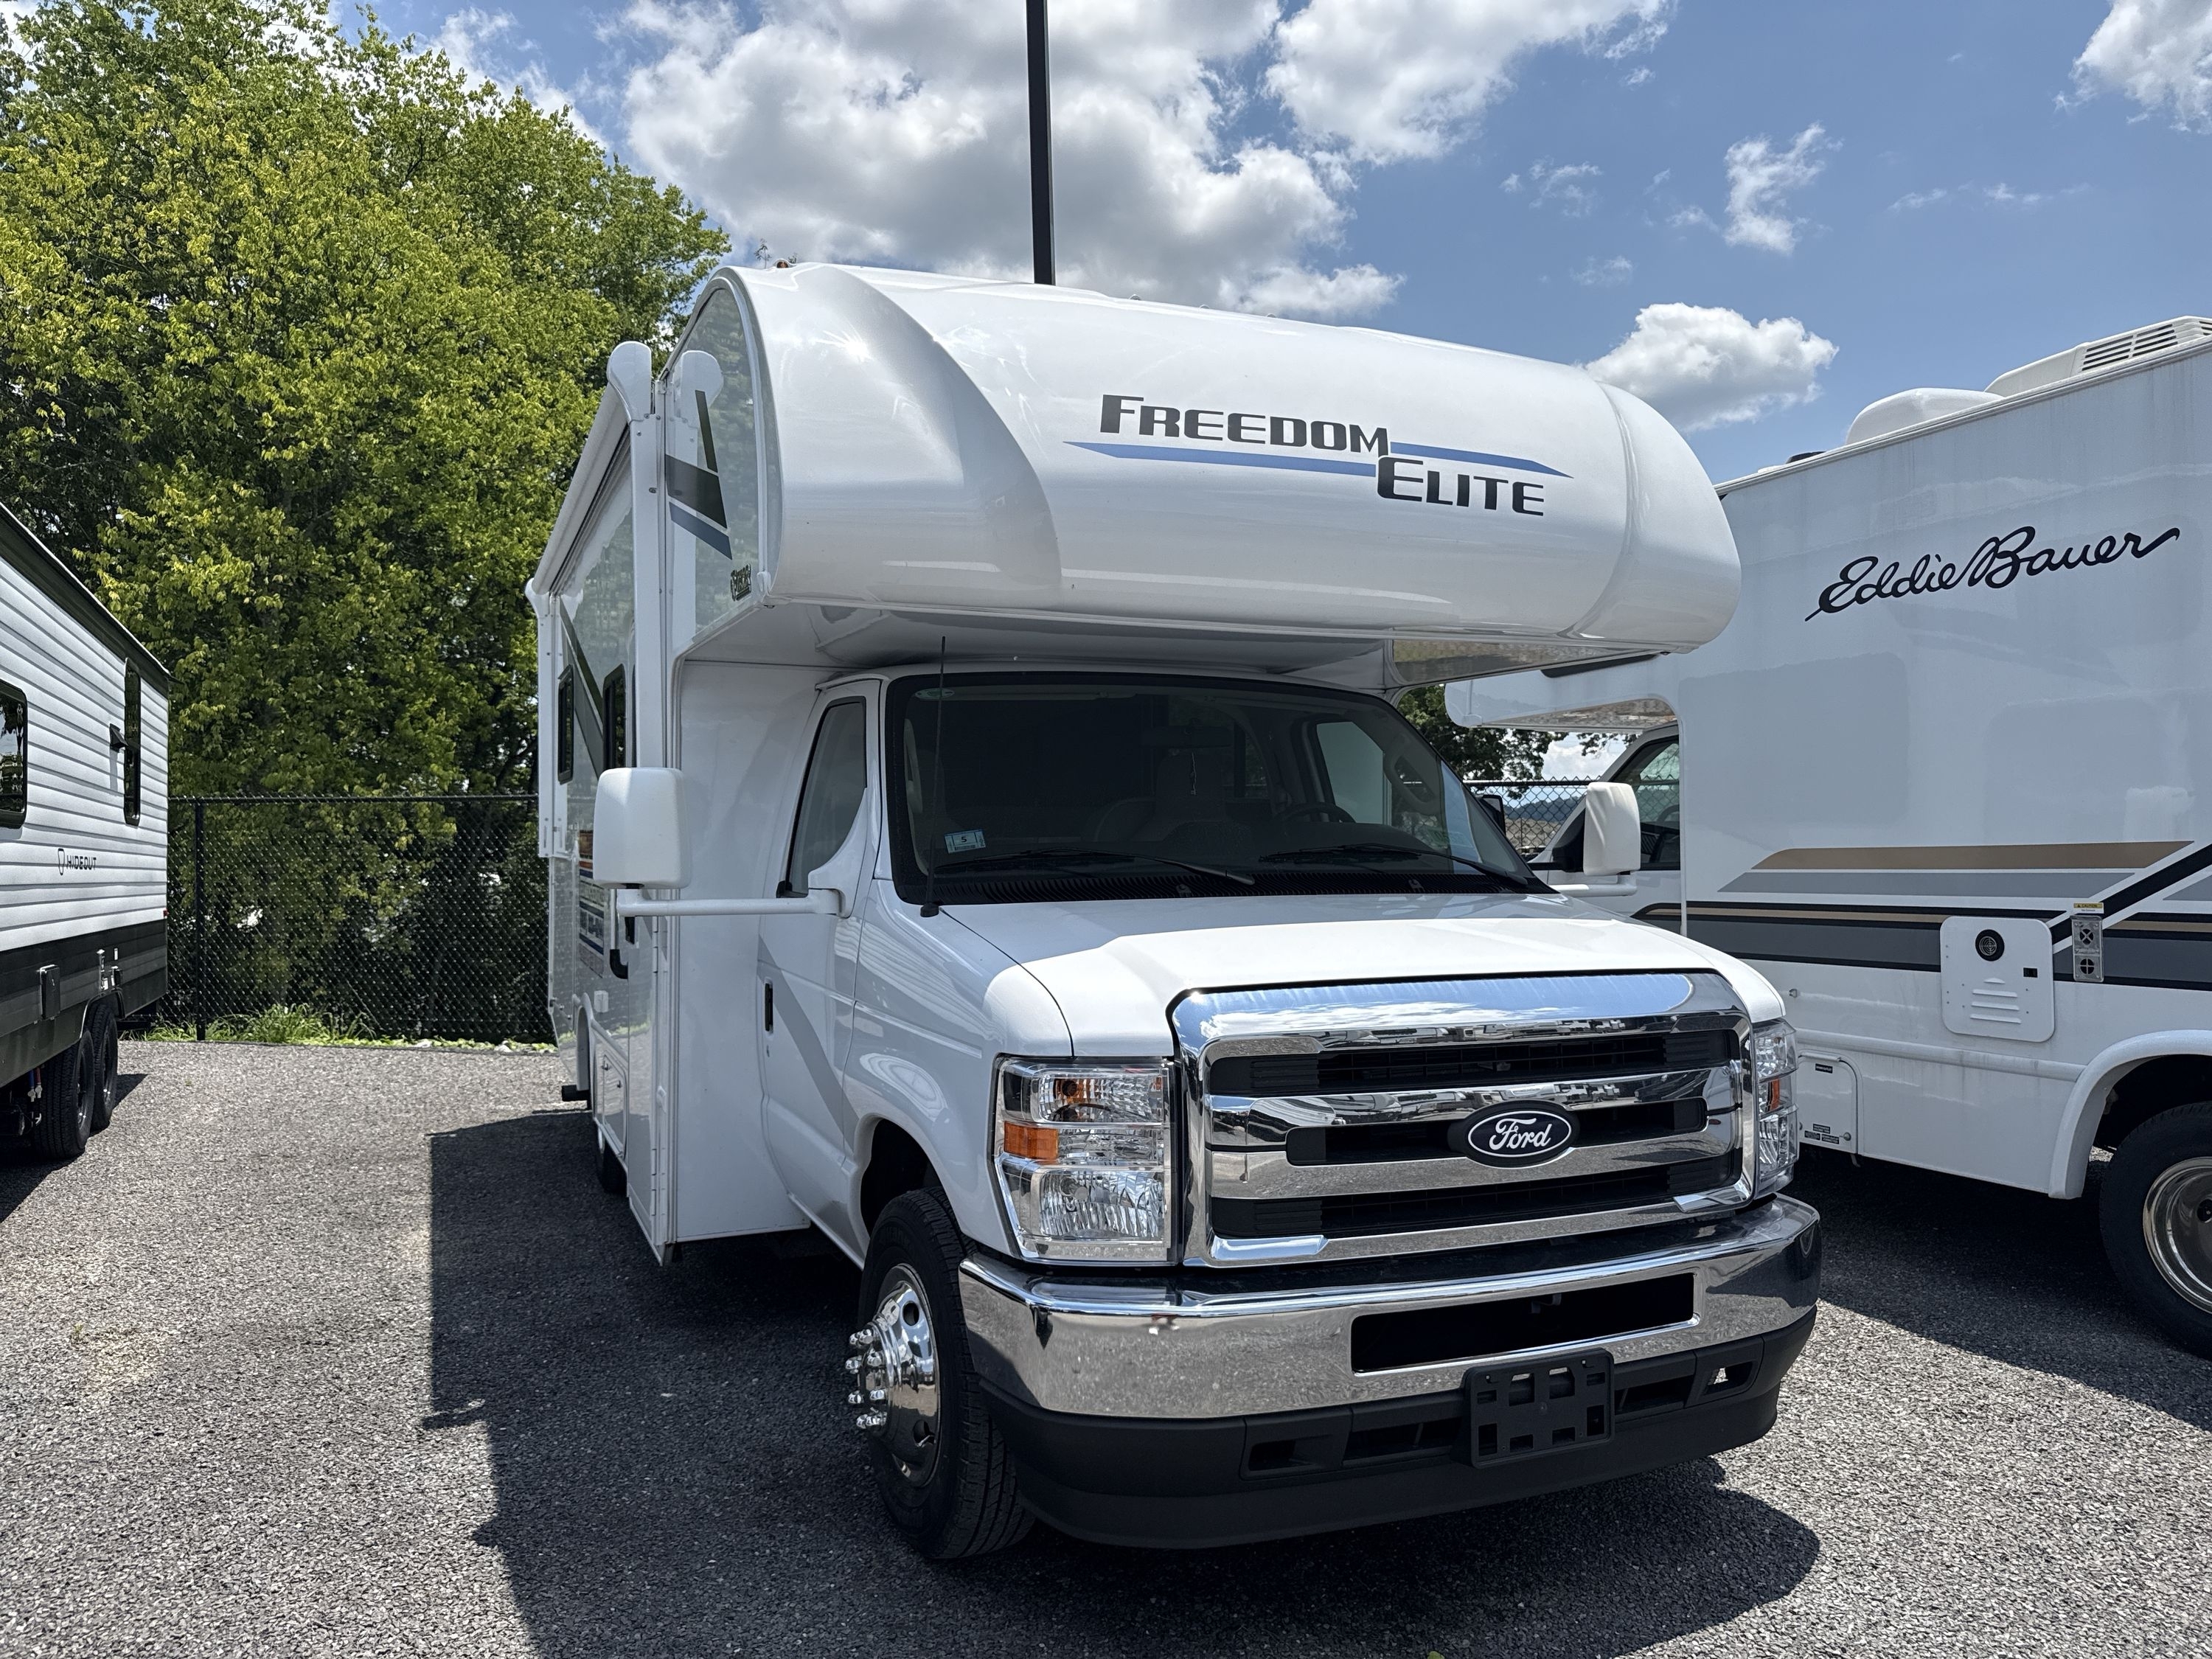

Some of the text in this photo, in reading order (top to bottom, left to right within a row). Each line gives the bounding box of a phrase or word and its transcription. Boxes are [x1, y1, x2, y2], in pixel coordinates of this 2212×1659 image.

[1099, 394, 1388, 456] FREEDOM
[1377, 456, 1544, 516] ELITE
[1805, 526, 2180, 622] Eddie Bauer
[66, 855, 97, 870] HIDEOUT
[1489, 1118, 1553, 1150] Ford
